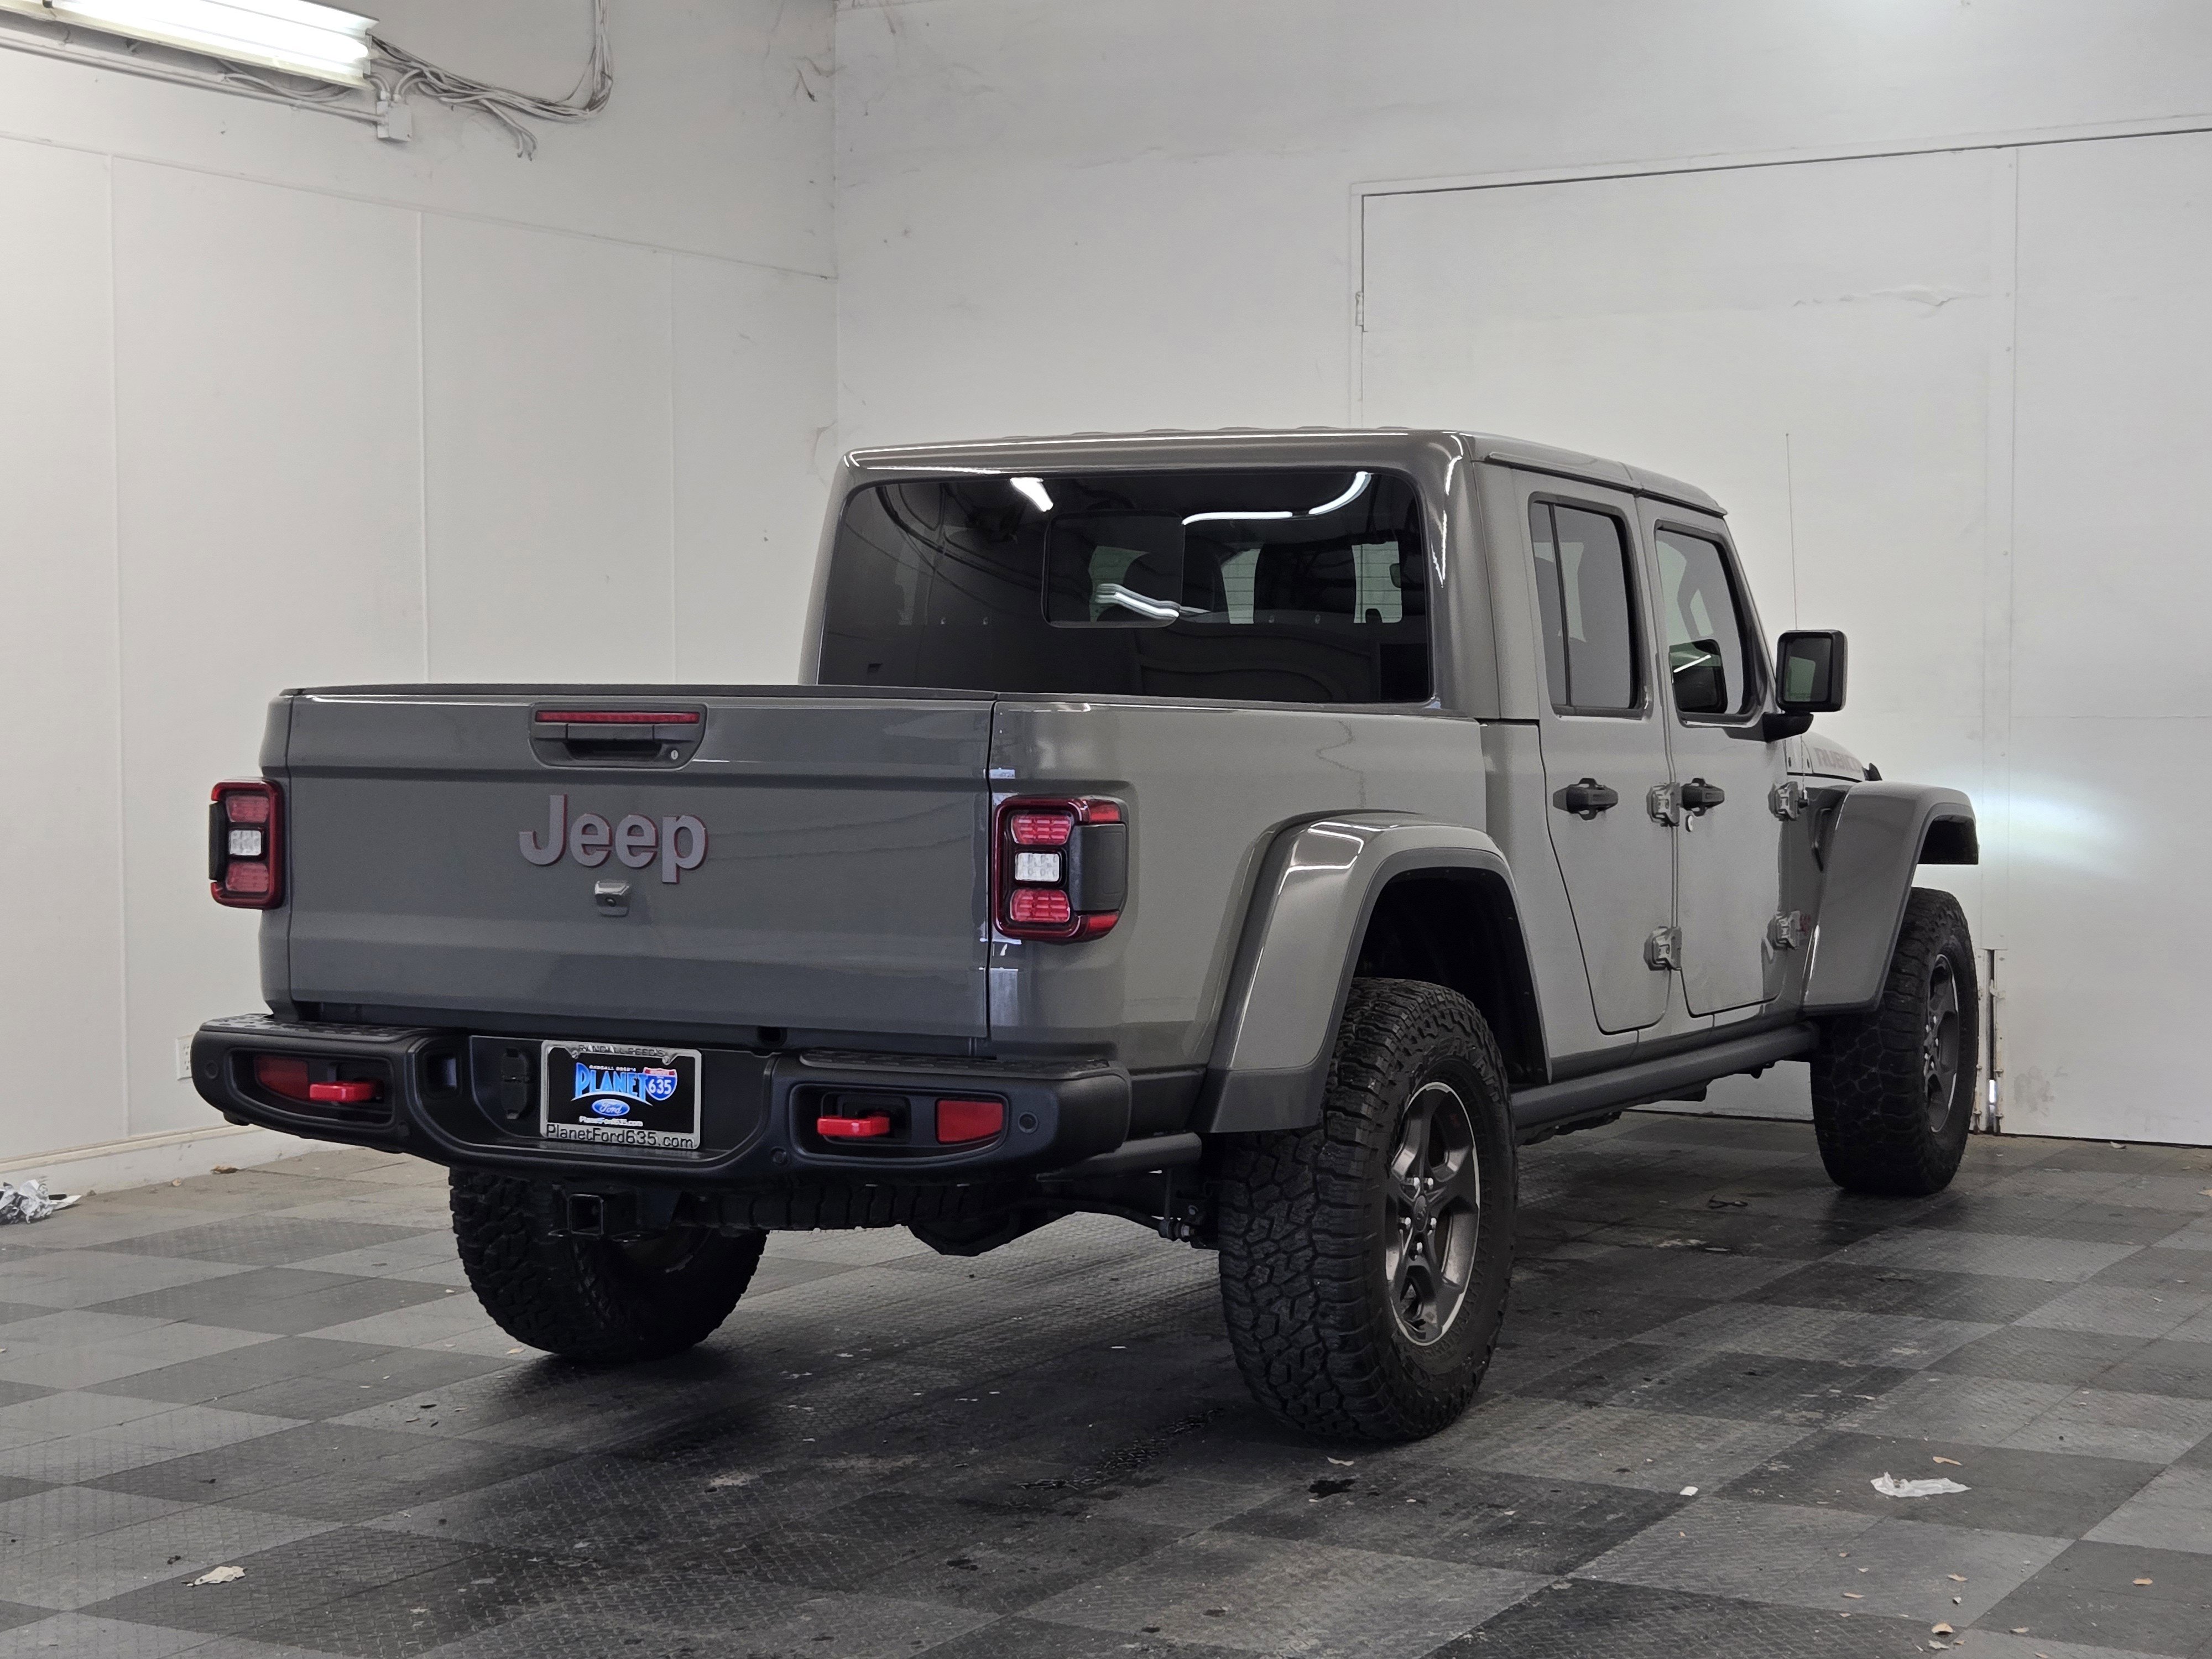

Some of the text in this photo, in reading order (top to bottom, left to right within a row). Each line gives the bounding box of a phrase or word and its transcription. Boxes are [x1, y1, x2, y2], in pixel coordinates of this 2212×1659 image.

[519, 794, 709, 884] Jeep
[575, 1062, 672, 1102] PLANET 635
[599, 1102, 623, 1114] Ford
[546, 1123, 694, 1149] PlanetFord635.com
